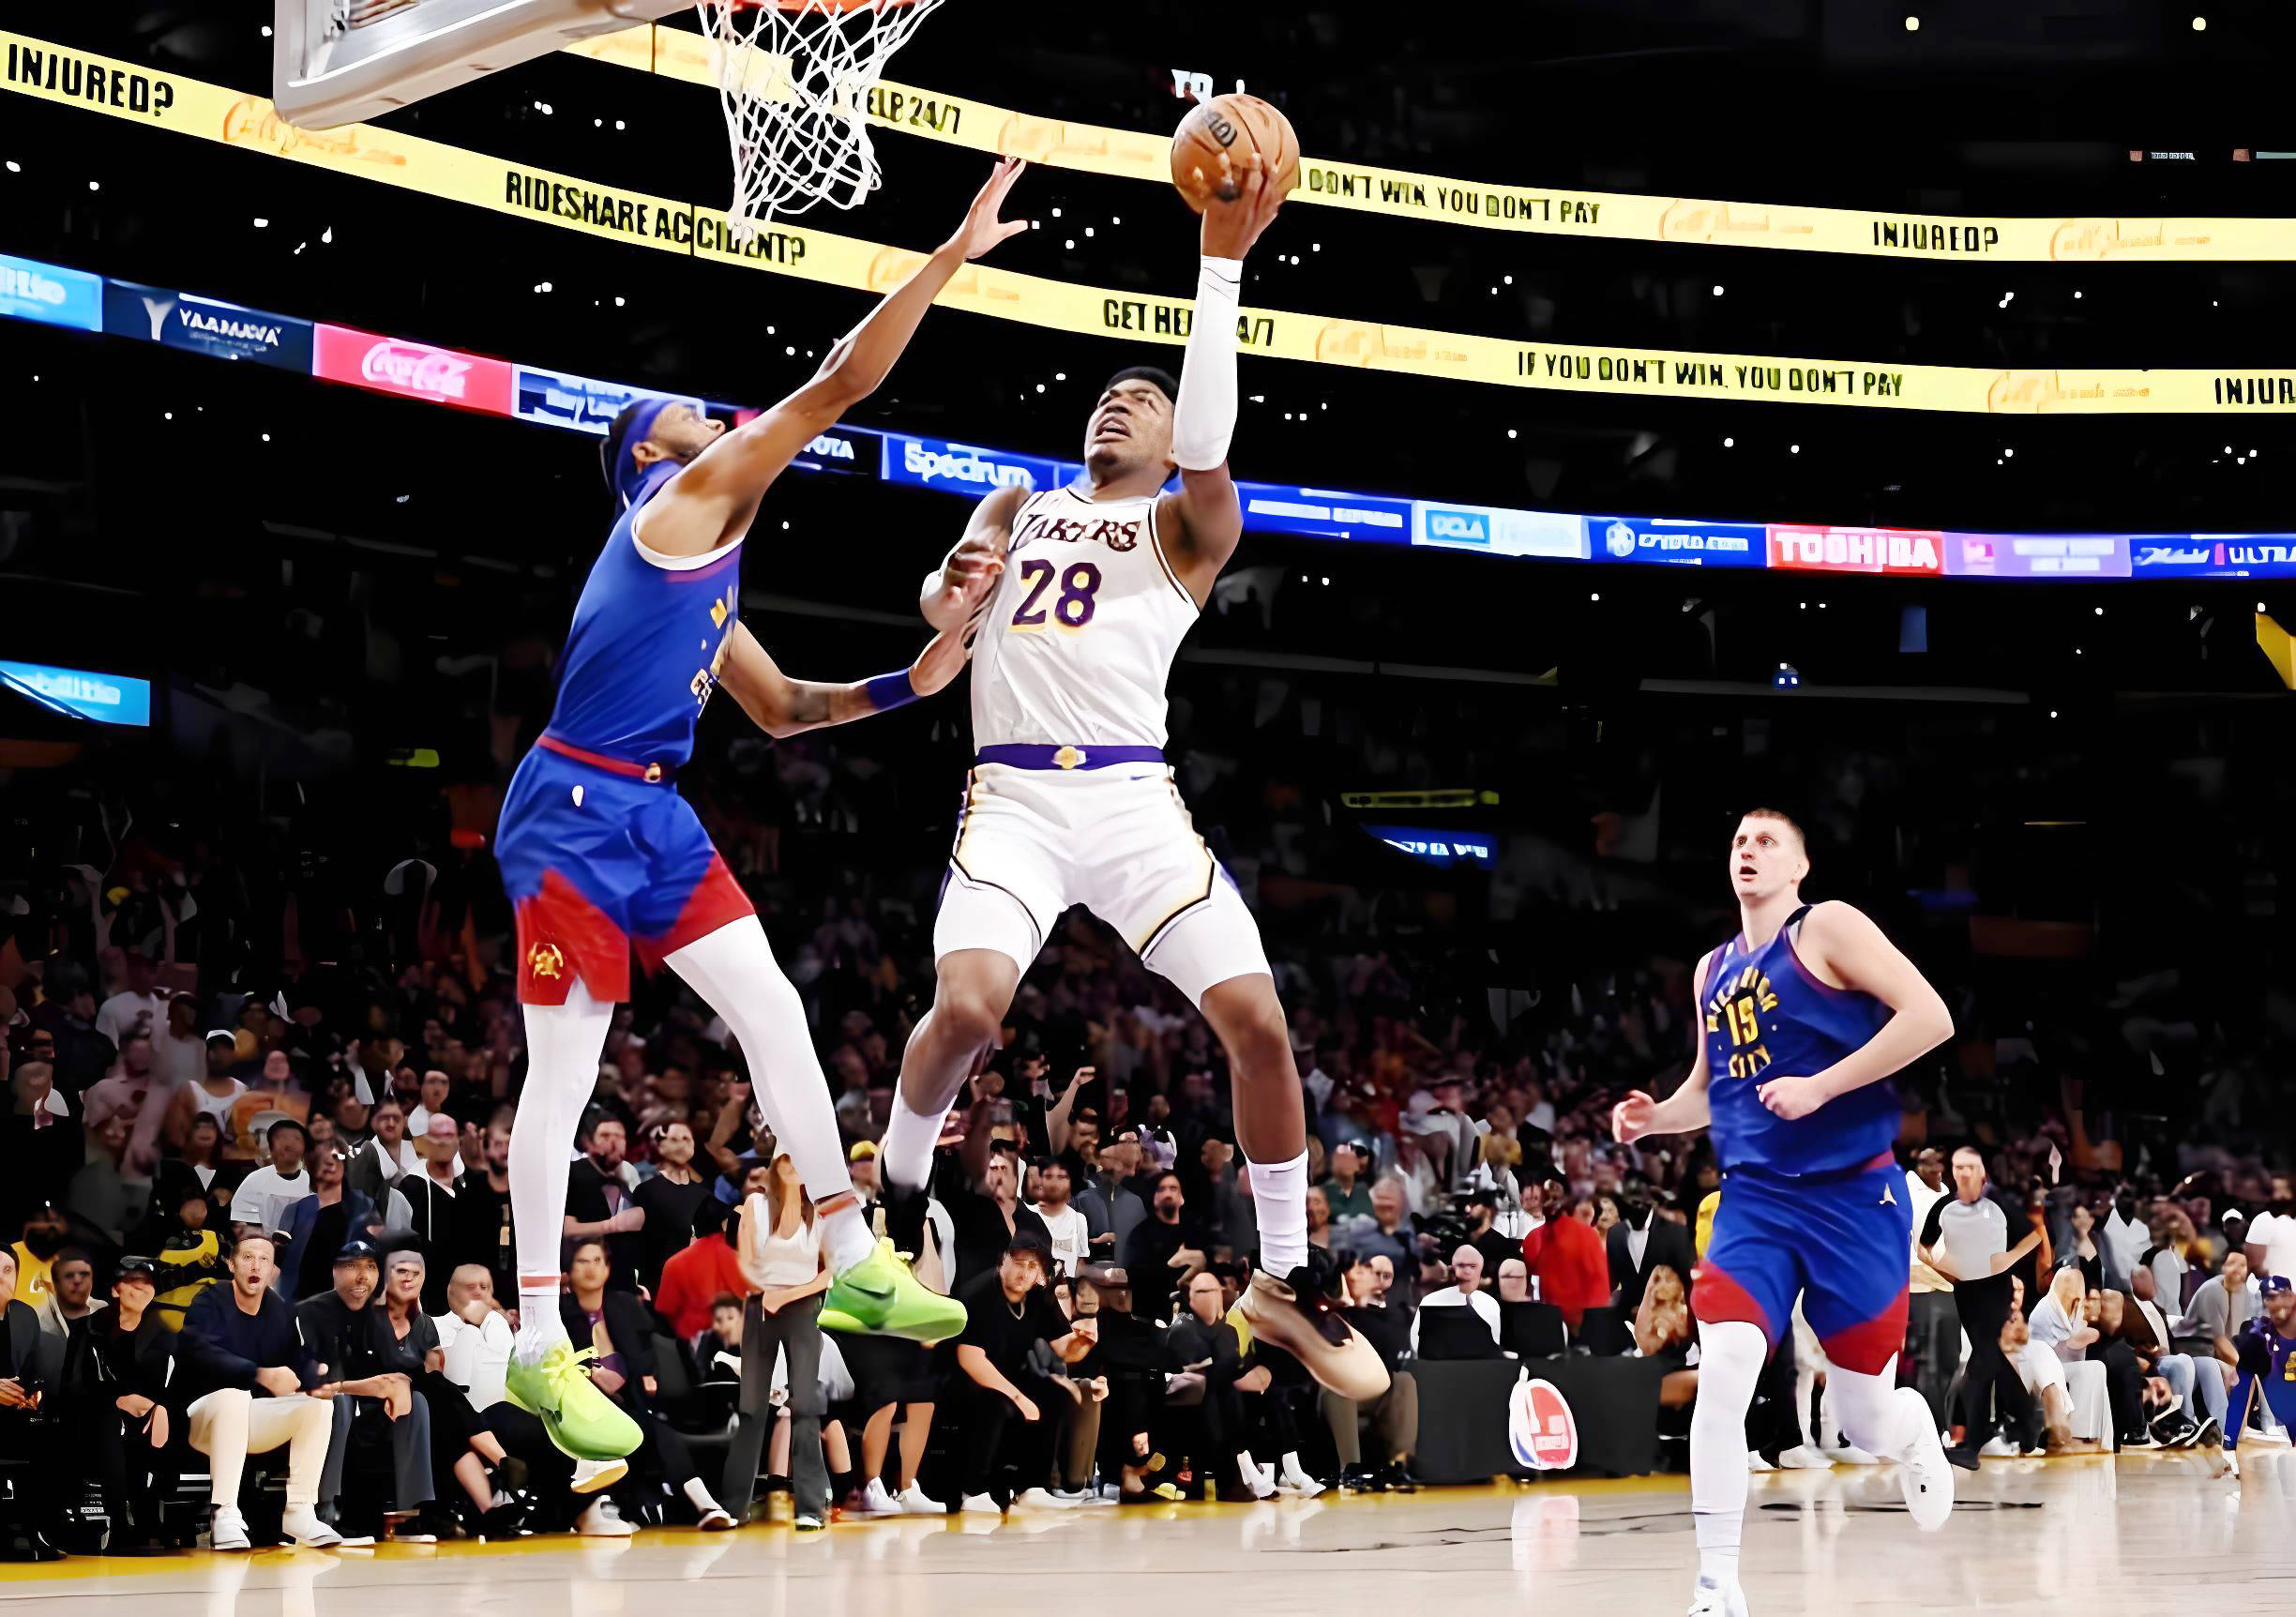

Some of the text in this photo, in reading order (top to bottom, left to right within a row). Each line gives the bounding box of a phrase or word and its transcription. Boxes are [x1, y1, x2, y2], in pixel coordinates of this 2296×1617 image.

[8, 43, 174, 116] INJURED?
[506, 171, 649, 236] RIDESHARE
[1437, 186, 1479, 215] YOU
[1560, 200, 1601, 224] PAY
[1103, 298, 1148, 332] GET
[1518, 351, 1536, 376] IF
[1545, 353, 1591, 380] YOU
[1734, 364, 1781, 390] YOU
[1863, 371, 1904, 396] PAY
[1775, 531, 1940, 570] TOSHIBA
[1009, 558, 1102, 632] 28
[1725, 995, 1760, 1047] 15
